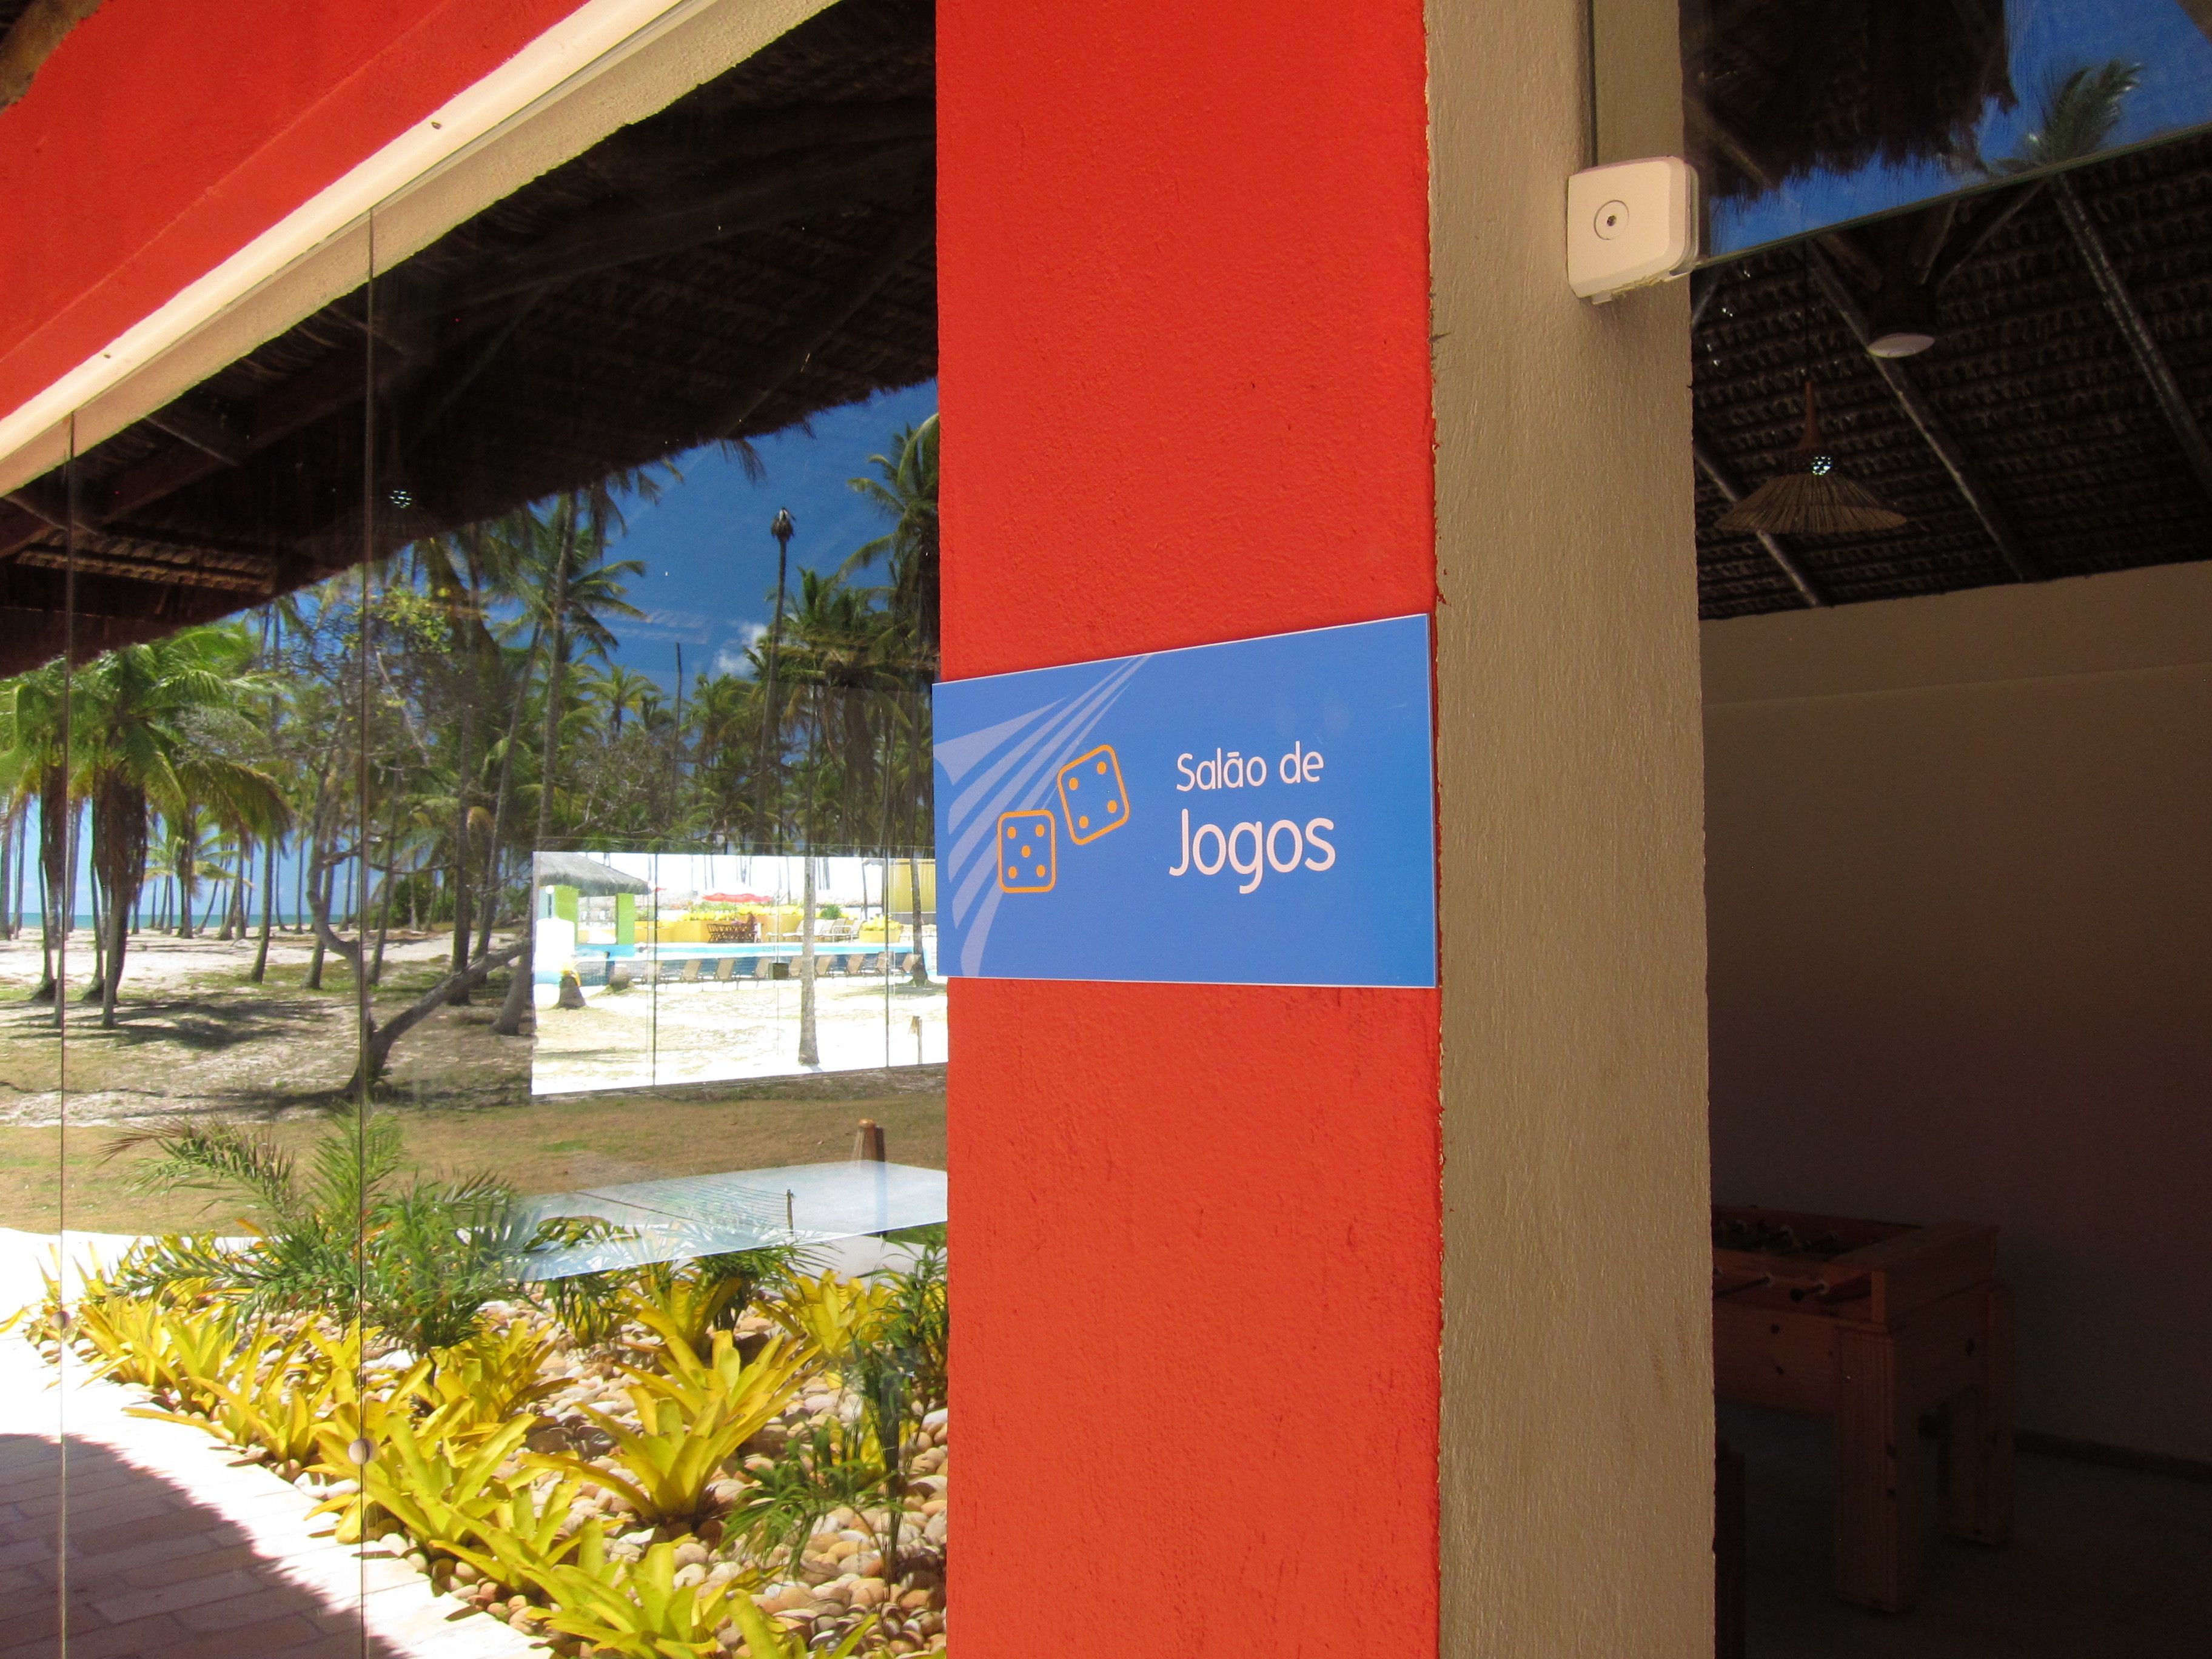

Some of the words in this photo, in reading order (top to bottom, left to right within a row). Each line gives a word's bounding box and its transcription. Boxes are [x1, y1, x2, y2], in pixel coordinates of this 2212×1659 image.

[1176, 747, 1267, 791] Salão
[1279, 740, 1324, 784] de
[1169, 808, 1336, 894] Jogos
